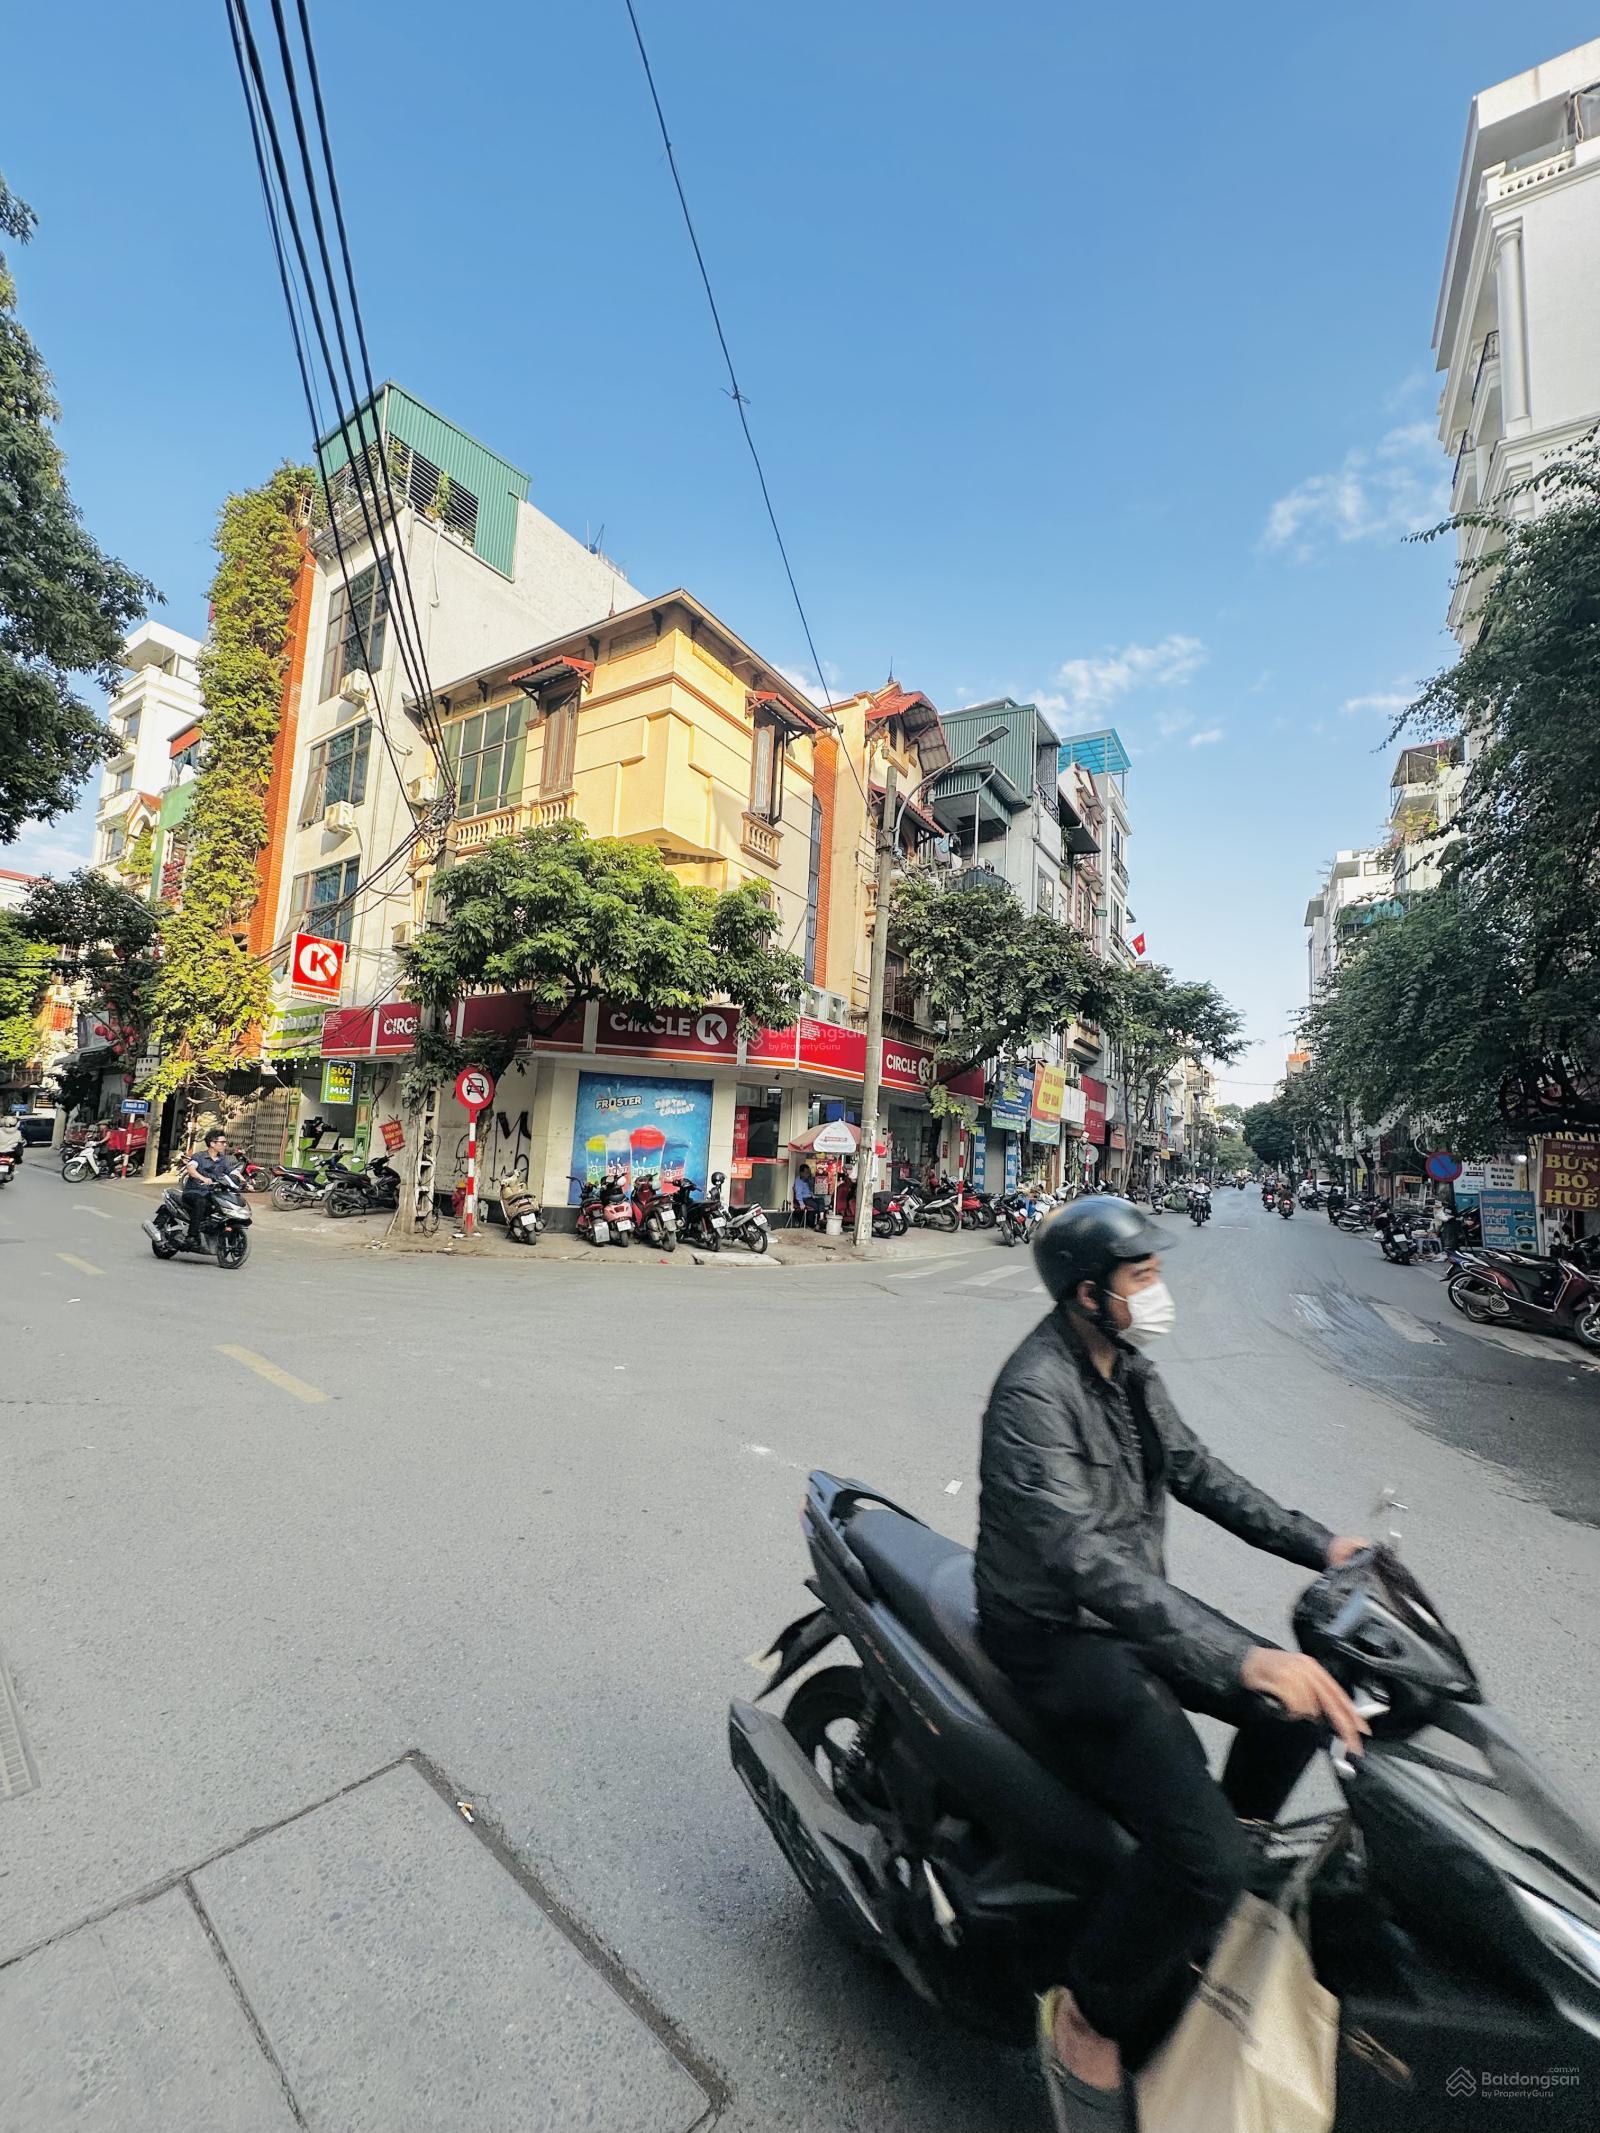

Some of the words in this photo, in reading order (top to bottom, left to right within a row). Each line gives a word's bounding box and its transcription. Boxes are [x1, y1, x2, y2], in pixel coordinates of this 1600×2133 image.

[303, 946, 336, 981] K
[383, 1016, 418, 1035] CIRC
[699, 1015, 727, 1045] K
[886, 1053, 917, 1075] CIRCLE
[1554, 1170, 1589, 1189] BÒ
[1544, 1186, 1599, 1208] HUẾ
